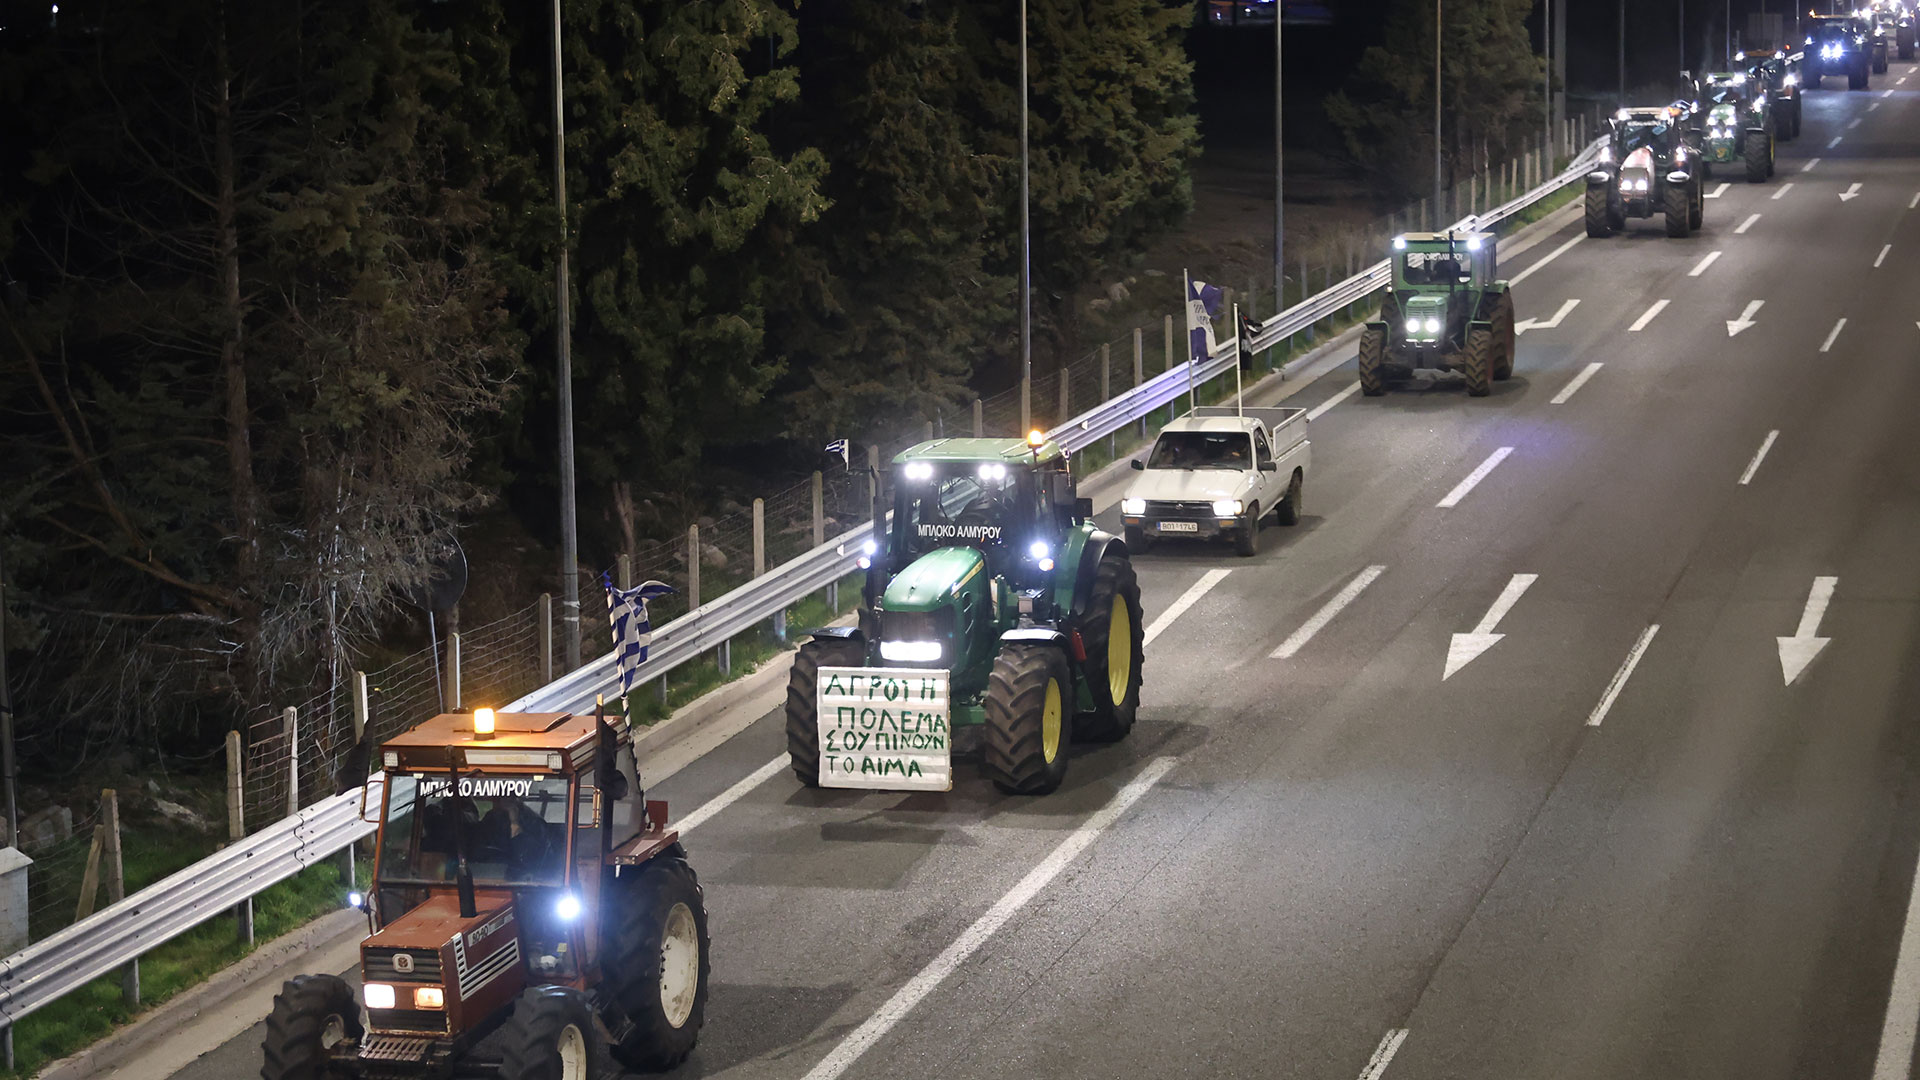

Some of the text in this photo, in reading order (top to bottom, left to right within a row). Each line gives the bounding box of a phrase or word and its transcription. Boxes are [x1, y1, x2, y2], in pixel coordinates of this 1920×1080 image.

[918, 524, 1001, 539] ΜΠΛΟΚΟ ΑΛΜΥΡΟΥ
[838, 706, 947, 733] ΠΟΛΕΜΑ
[826, 729, 944, 752] ΣΟΥ ΠΙΝΟΥΝ
[825, 755, 923, 778] ΤΟ ΑΙΜΑ
[473, 780, 533, 797] ΑΛΜΥΡΟΥ
